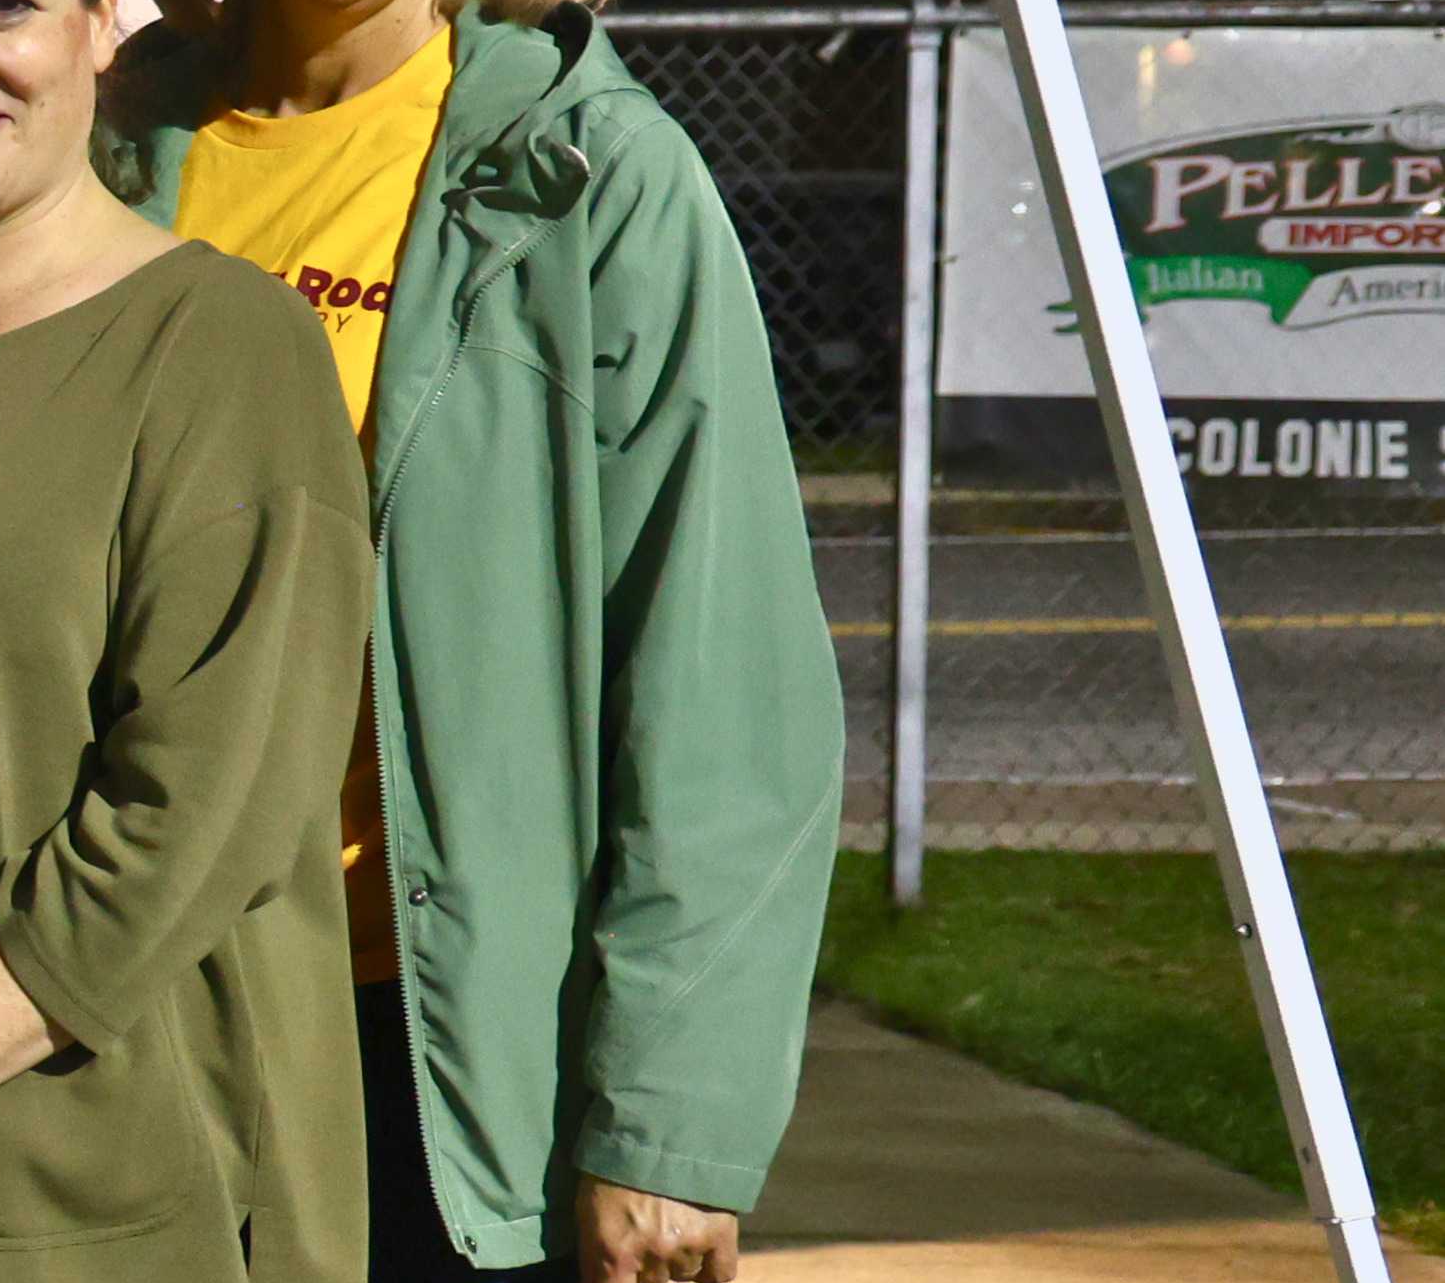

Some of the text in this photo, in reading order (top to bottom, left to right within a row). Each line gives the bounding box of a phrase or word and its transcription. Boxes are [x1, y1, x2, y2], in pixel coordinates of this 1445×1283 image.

[1144, 153, 1445, 234] PELLE
[1328, 274, 1445, 307] Ameri
[1167, 417, 1411, 479] COLONIE
